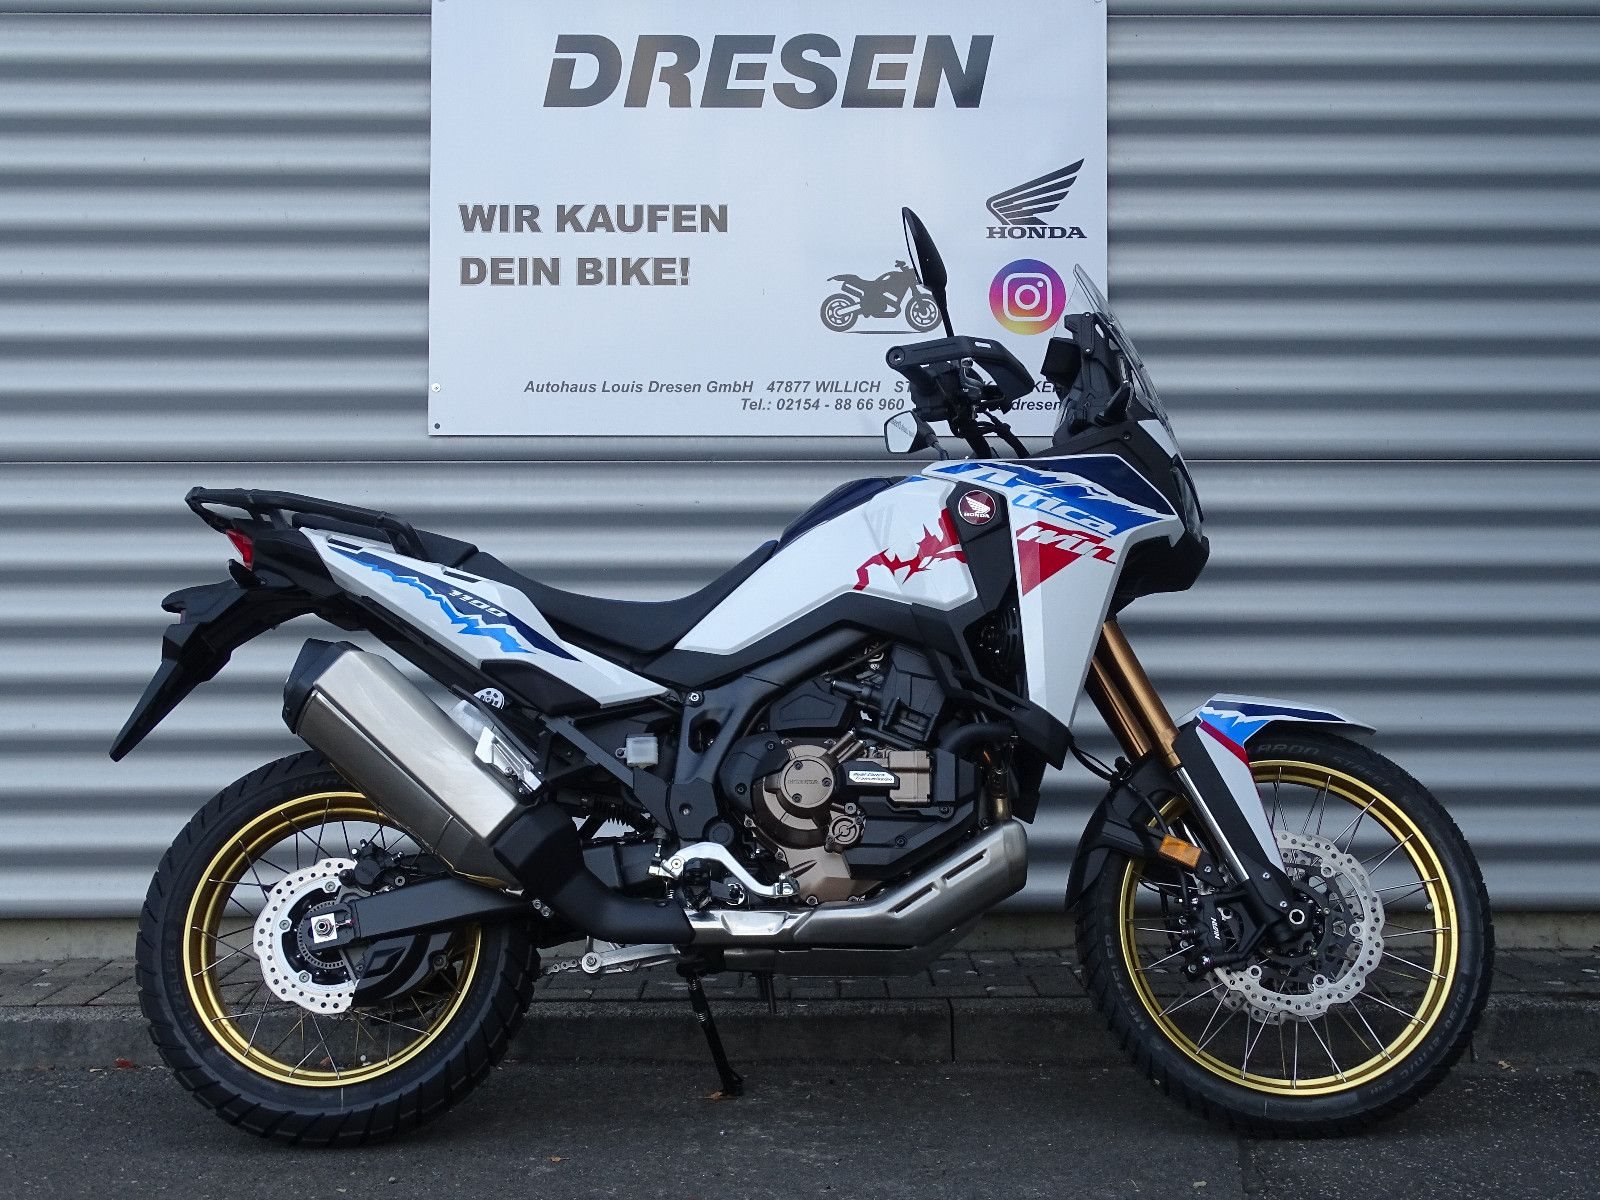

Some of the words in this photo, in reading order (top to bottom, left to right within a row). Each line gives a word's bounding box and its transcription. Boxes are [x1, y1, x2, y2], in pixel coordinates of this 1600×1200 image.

[543, 33, 994, 109] DRESEN
[458, 204, 542, 233] WIR
[556, 204, 728, 233] KAUFEN
[985, 226, 1088, 240] HONDA
[460, 257, 560, 286] DEIN
[577, 257, 691, 287] BIKE!
[523, 380, 597, 393] Autohaus
[601, 380, 644, 393] Louis
[647, 380, 702, 393] Dresen
[706, 380, 754, 393] GmbH
[766, 380, 811, 393] 47877
[815, 380, 881, 393] WILLICH
[740, 398, 772, 411] Tel.:
[776, 398, 821, 411] 02154
[834, 398, 852, 411] 88
[856, 398, 874, 411] 66
[878, 398, 905, 411] 960
[448, 589, 508, 617] 1100
